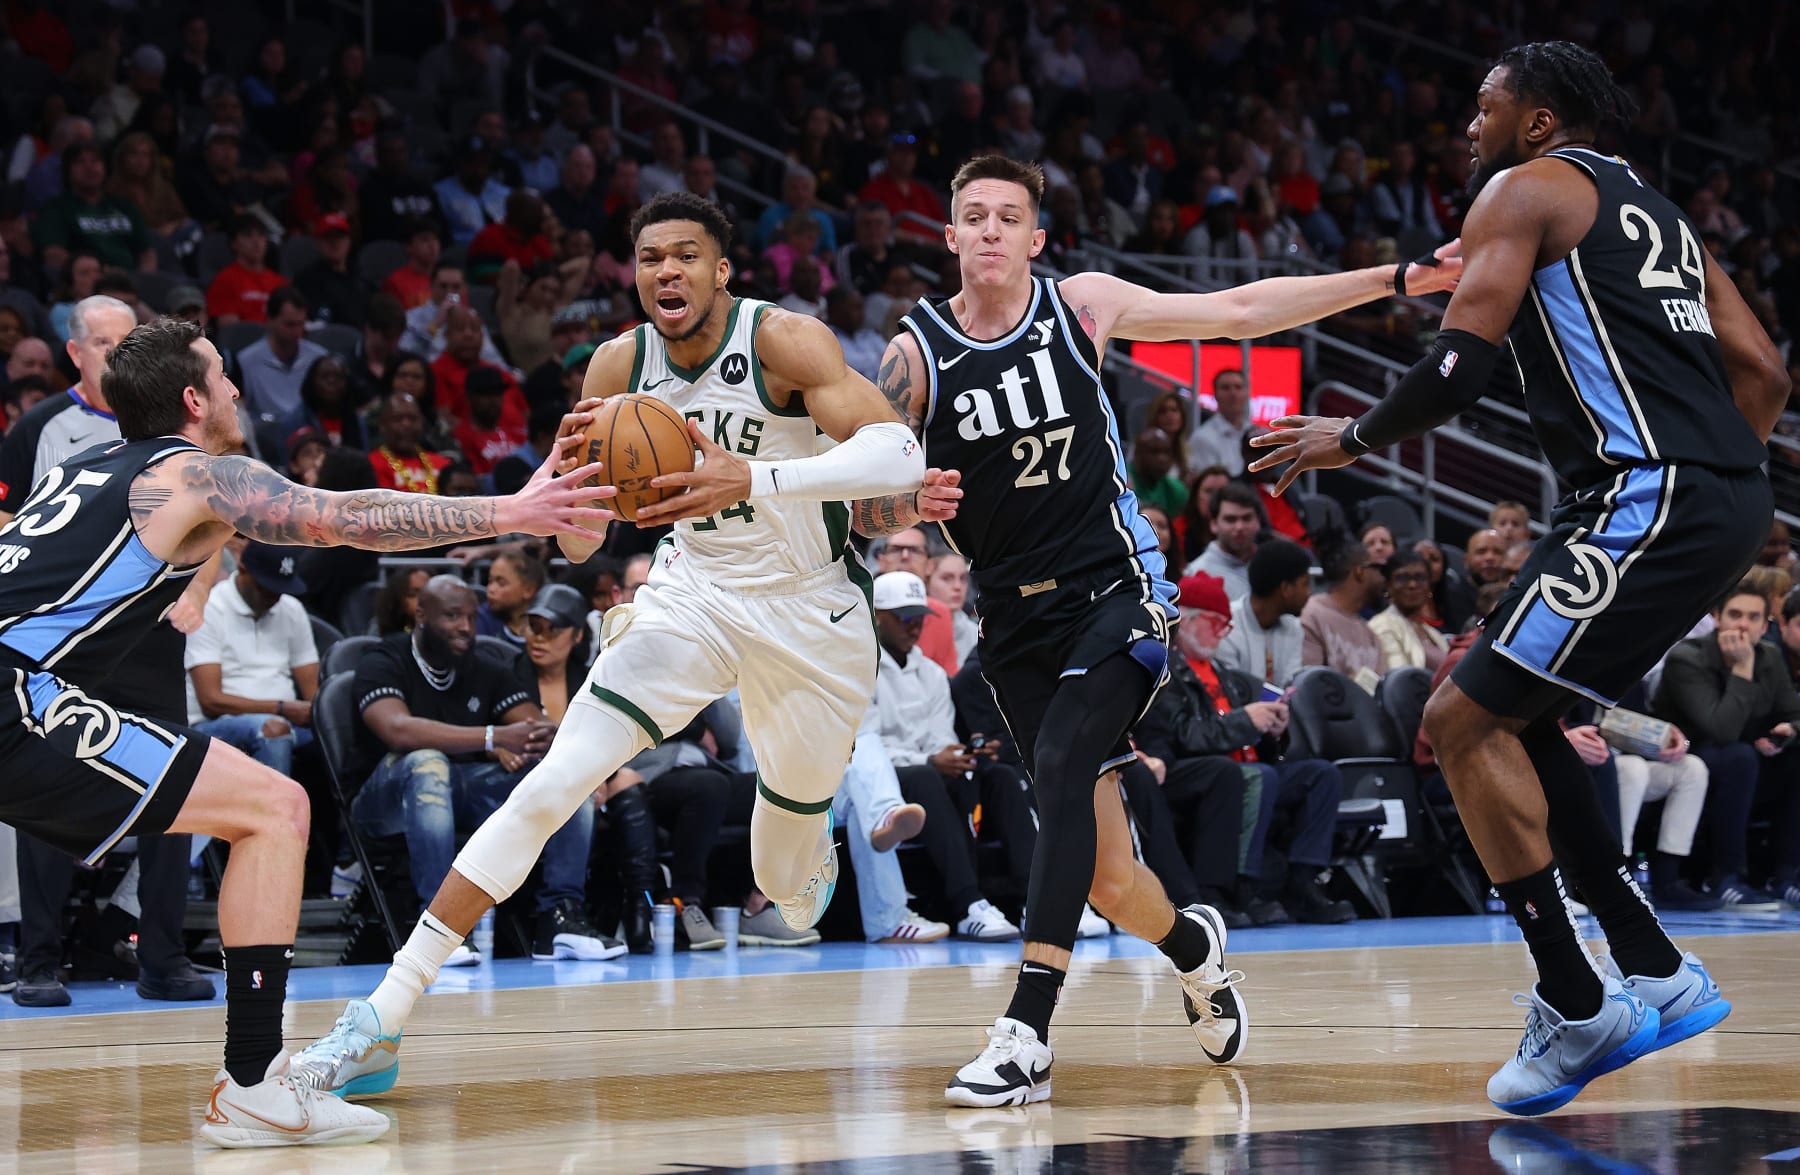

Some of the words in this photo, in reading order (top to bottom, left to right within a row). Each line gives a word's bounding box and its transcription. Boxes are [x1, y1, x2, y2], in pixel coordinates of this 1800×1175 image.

[1620, 204, 1705, 305] 24
[1660, 298, 1717, 339] FERN
[954, 347, 1070, 441] atl
[1011, 425, 1076, 488] 27
[341, 496, 491, 537] Sacrifice
